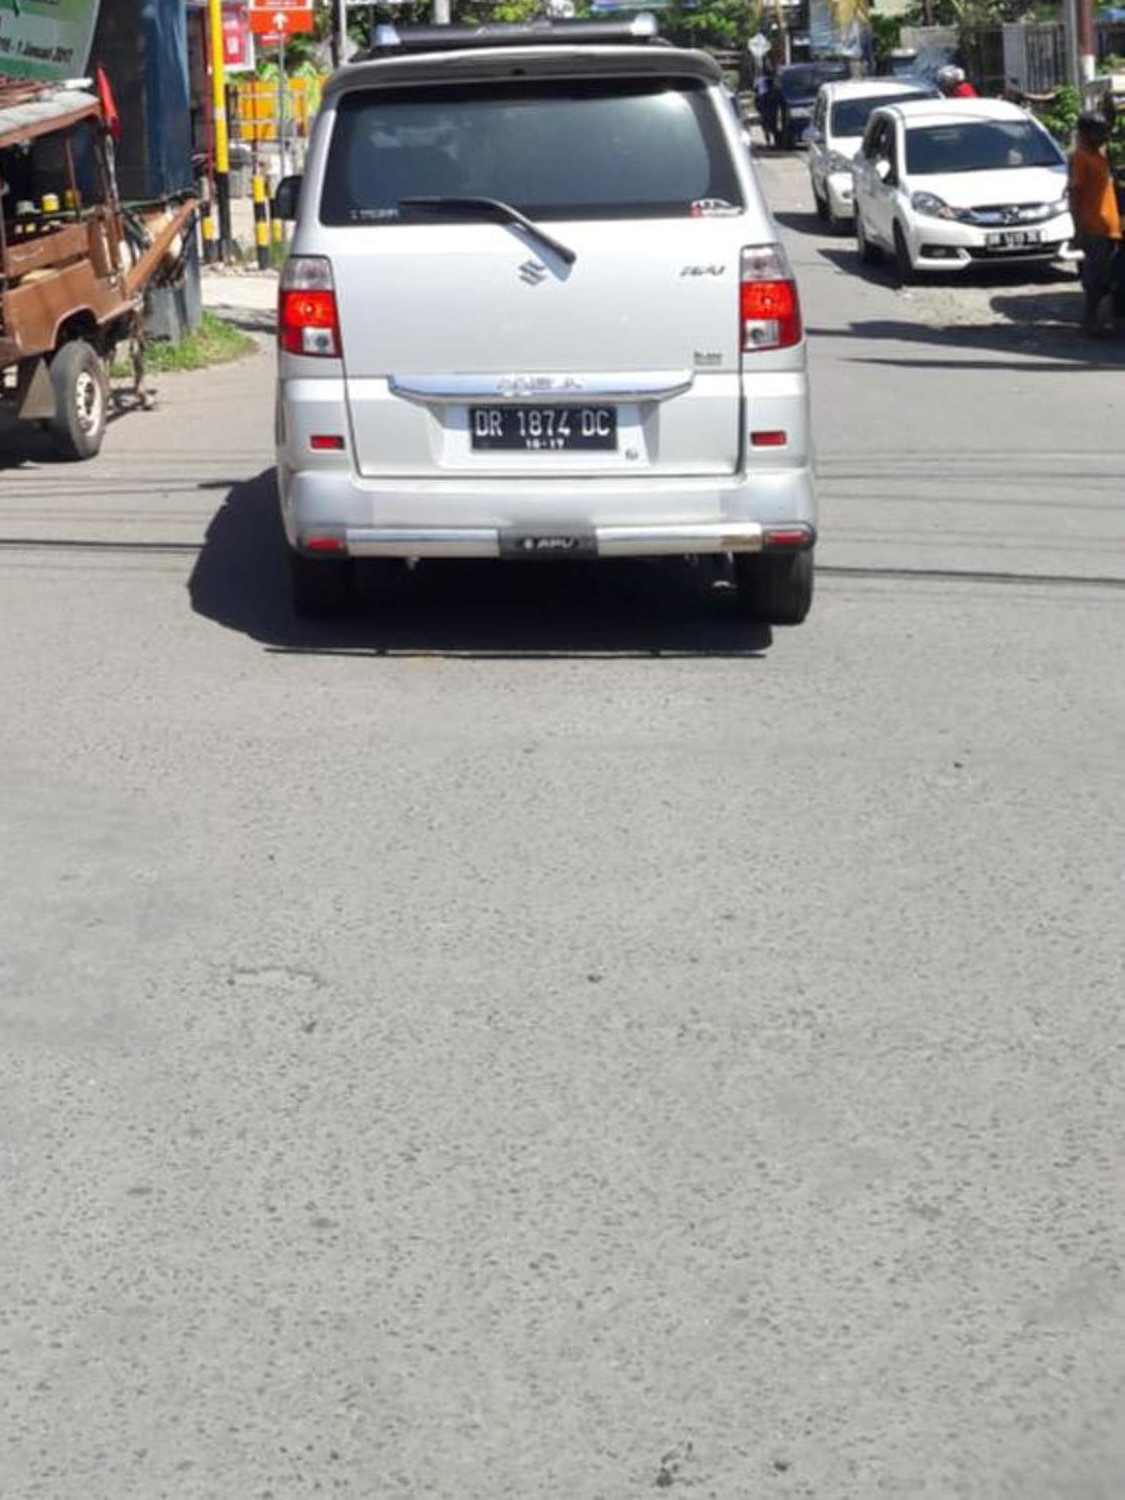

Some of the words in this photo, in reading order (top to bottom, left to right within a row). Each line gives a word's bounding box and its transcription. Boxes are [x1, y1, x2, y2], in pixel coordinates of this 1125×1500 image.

[475, 410, 504, 438] DR
[516, 410, 572, 438] 1874
[581, 409, 612, 438] DC
